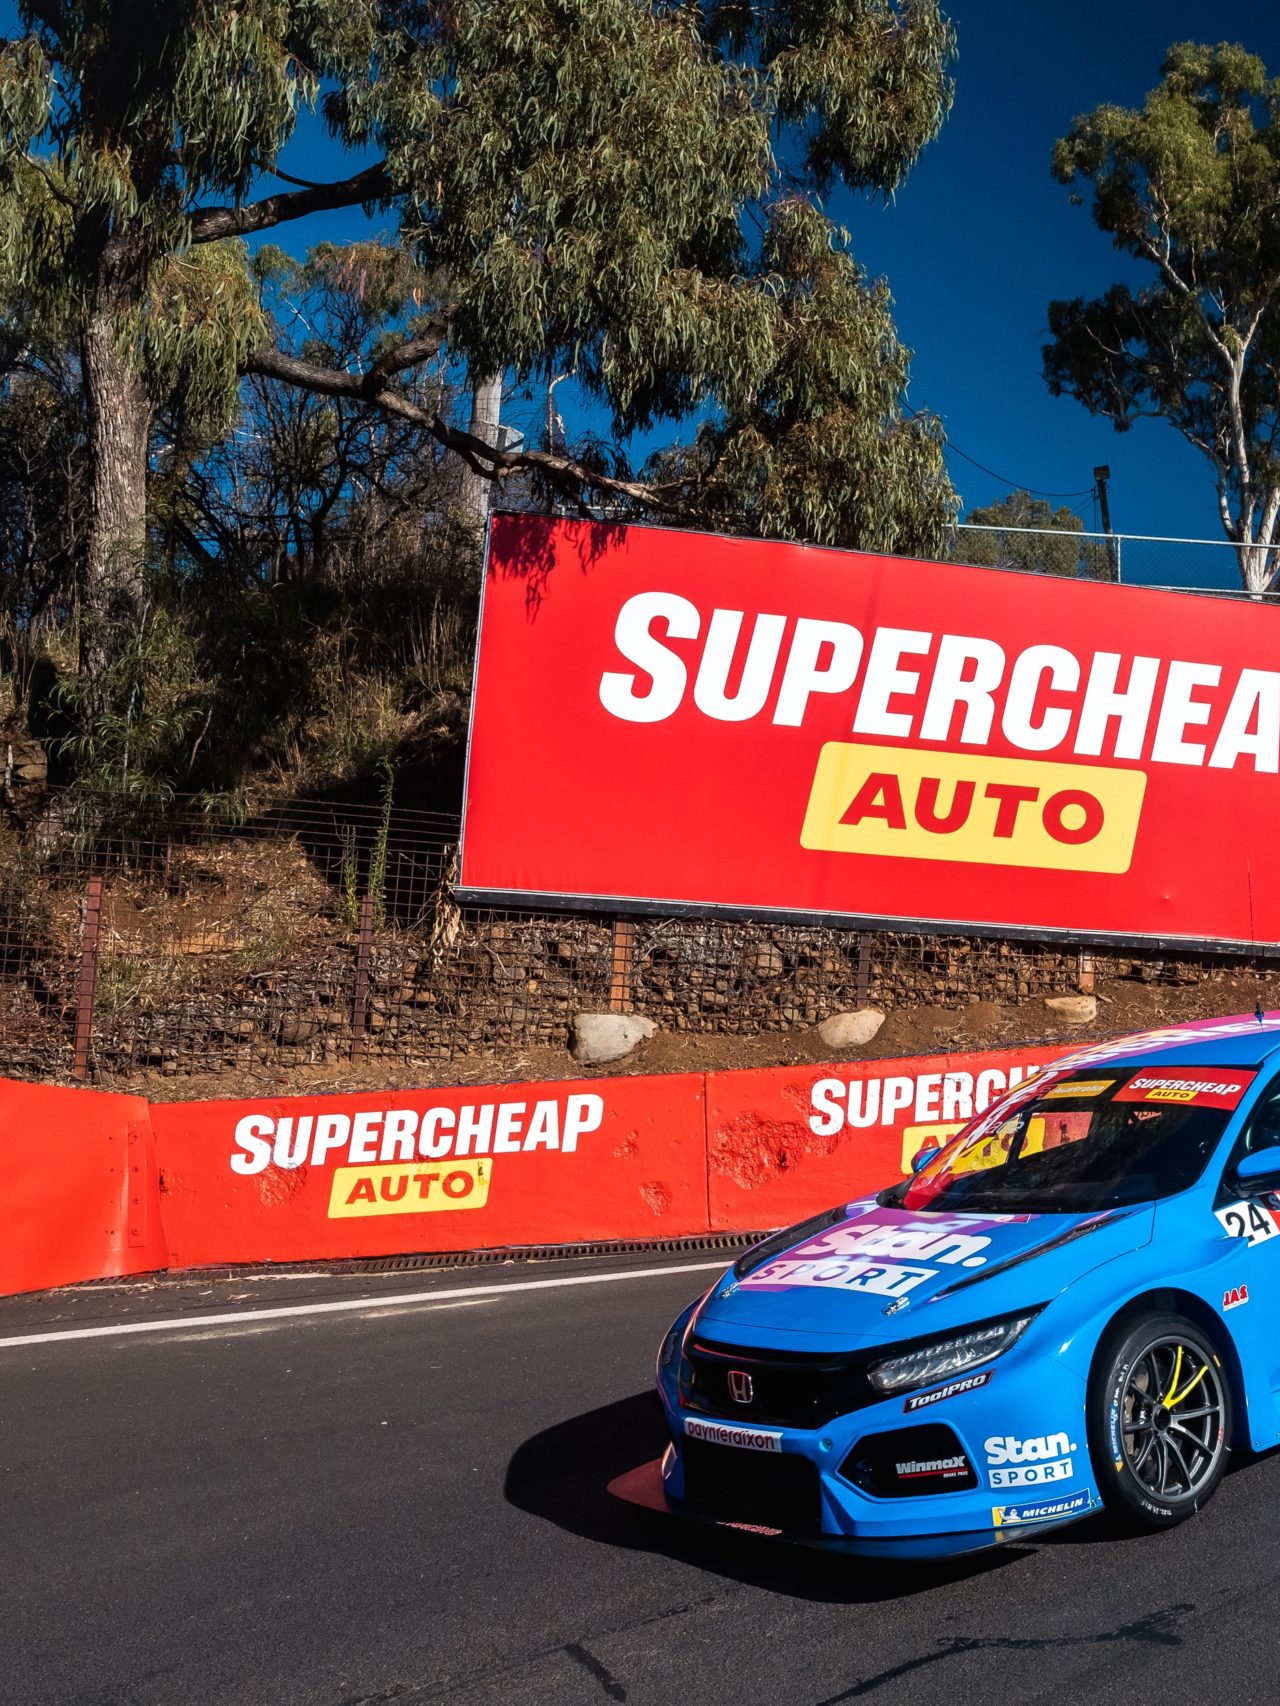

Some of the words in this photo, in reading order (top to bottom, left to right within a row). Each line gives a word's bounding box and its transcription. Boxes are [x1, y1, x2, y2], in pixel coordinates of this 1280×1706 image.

[838, 772, 1105, 845] AUTO
[808, 1063, 1045, 1137] SUPERC
[1128, 1078, 1242, 1096] SUPERCHEAP
[1152, 1091, 1190, 1099] AUTO
[230, 1094, 604, 1176] SUPERCHEAP
[344, 1168, 475, 1205] AUTO
[1225, 1203, 1271, 1242] 24
[751, 1261, 926, 1291] SPORT
[1223, 1285, 1248, 1307] JAS
[688, 1419, 775, 1450] paynterdixon
[984, 1432, 1077, 1465] Stan.
[992, 1462, 1069, 1485] SPORT
[1022, 1498, 1083, 1518] MICHELIN
